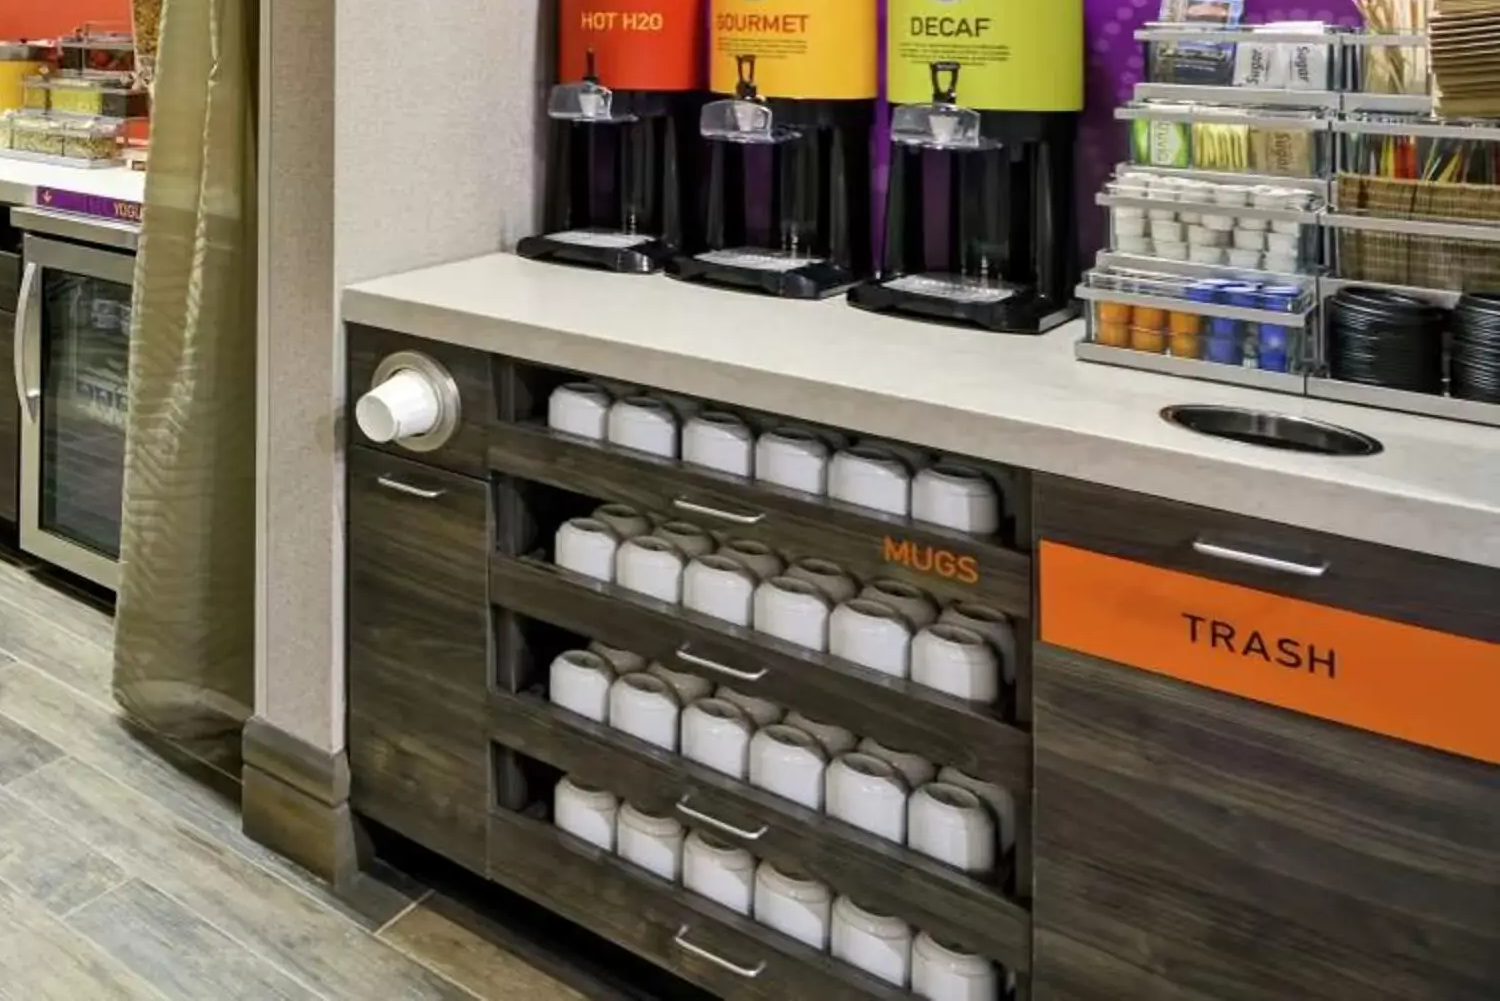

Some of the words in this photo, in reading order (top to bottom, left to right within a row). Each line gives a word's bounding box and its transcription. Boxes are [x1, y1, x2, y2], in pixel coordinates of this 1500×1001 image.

[581, 11, 618, 31] HOT
[716, 12, 810, 34] GOURMET
[910, 16, 992, 38] DECAF
[1245, 48, 1263, 86] Sugar
[1294, 45, 1311, 83] Sugar
[1271, 132, 1291, 172] Sugar
[883, 535, 979, 585] MUGS
[1181, 612, 1336, 680] TRASH
